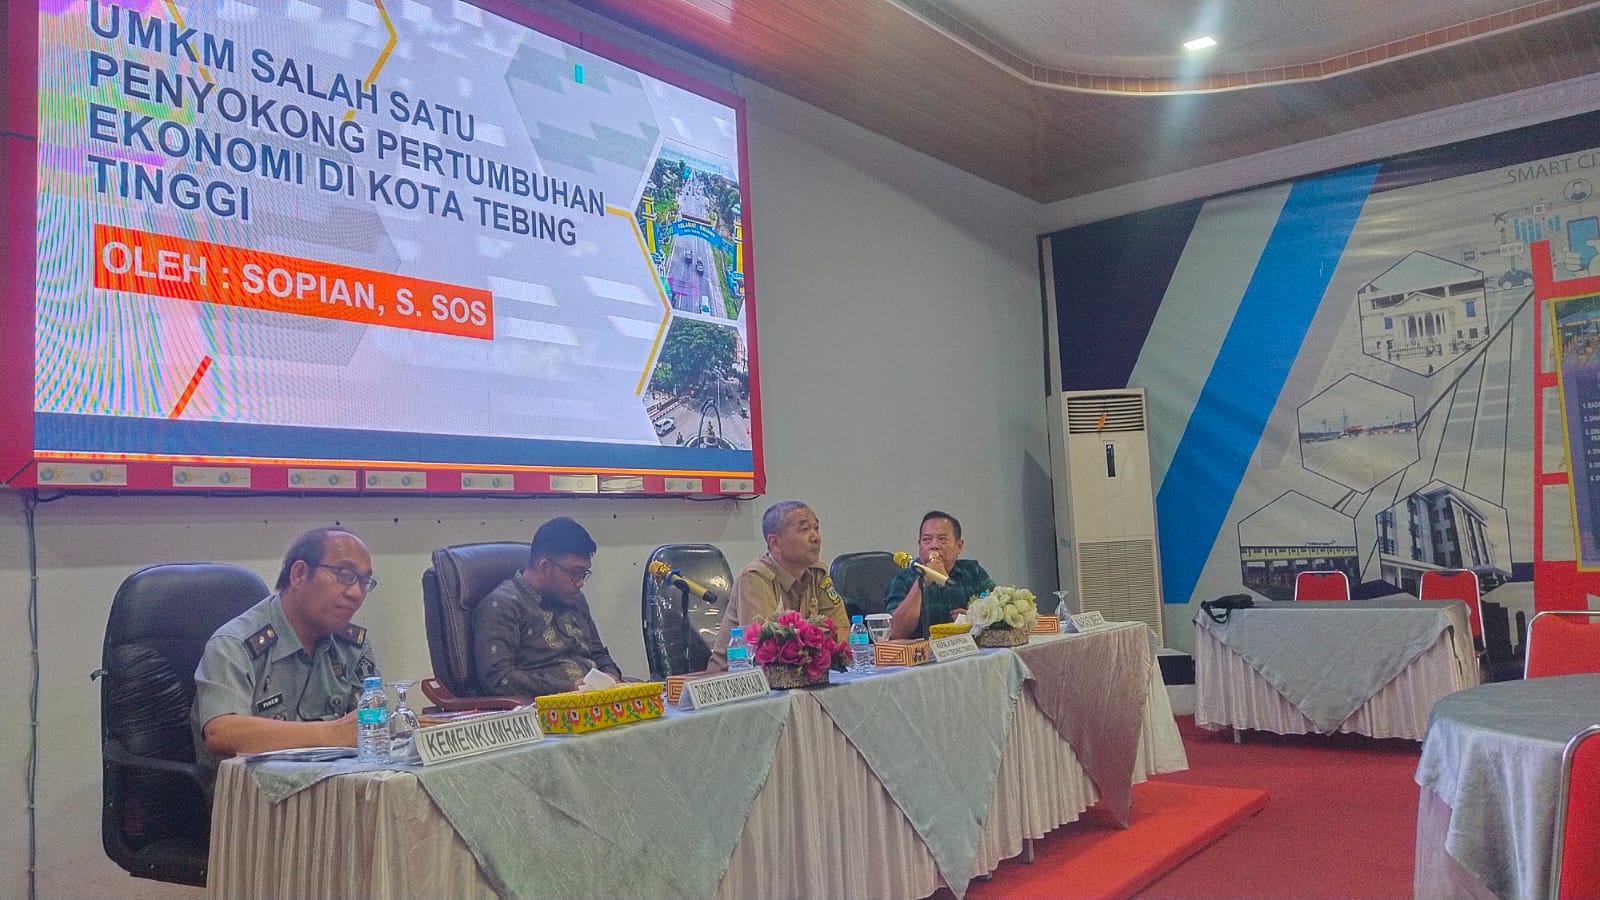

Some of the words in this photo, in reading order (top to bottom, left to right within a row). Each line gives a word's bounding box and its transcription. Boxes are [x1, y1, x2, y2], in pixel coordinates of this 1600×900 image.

[91, 0, 234, 73] UMKM
[251, 48, 378, 114] SALAH
[389, 91, 475, 142] SATU
[89, 102, 303, 185] EKONOMI
[319, 158, 355, 197] DI
[369, 170, 464, 222] KOTA
[473, 196, 577, 246] TEBING
[90, 50, 365, 153] PENYOKONG
[377, 129, 605, 217] PERTUMBUHAN
[1506, 158, 1572, 184] SMART
[87, 154, 249, 221] TINGGI
[102, 241, 207, 287] OLEH
[221, 267, 230, 289] :
[241, 263, 384, 317] SOPIAN,
[395, 288, 422, 317] S.
[431, 294, 488, 326] SOS
[425, 715, 535, 757] KEMENKUMHAM
